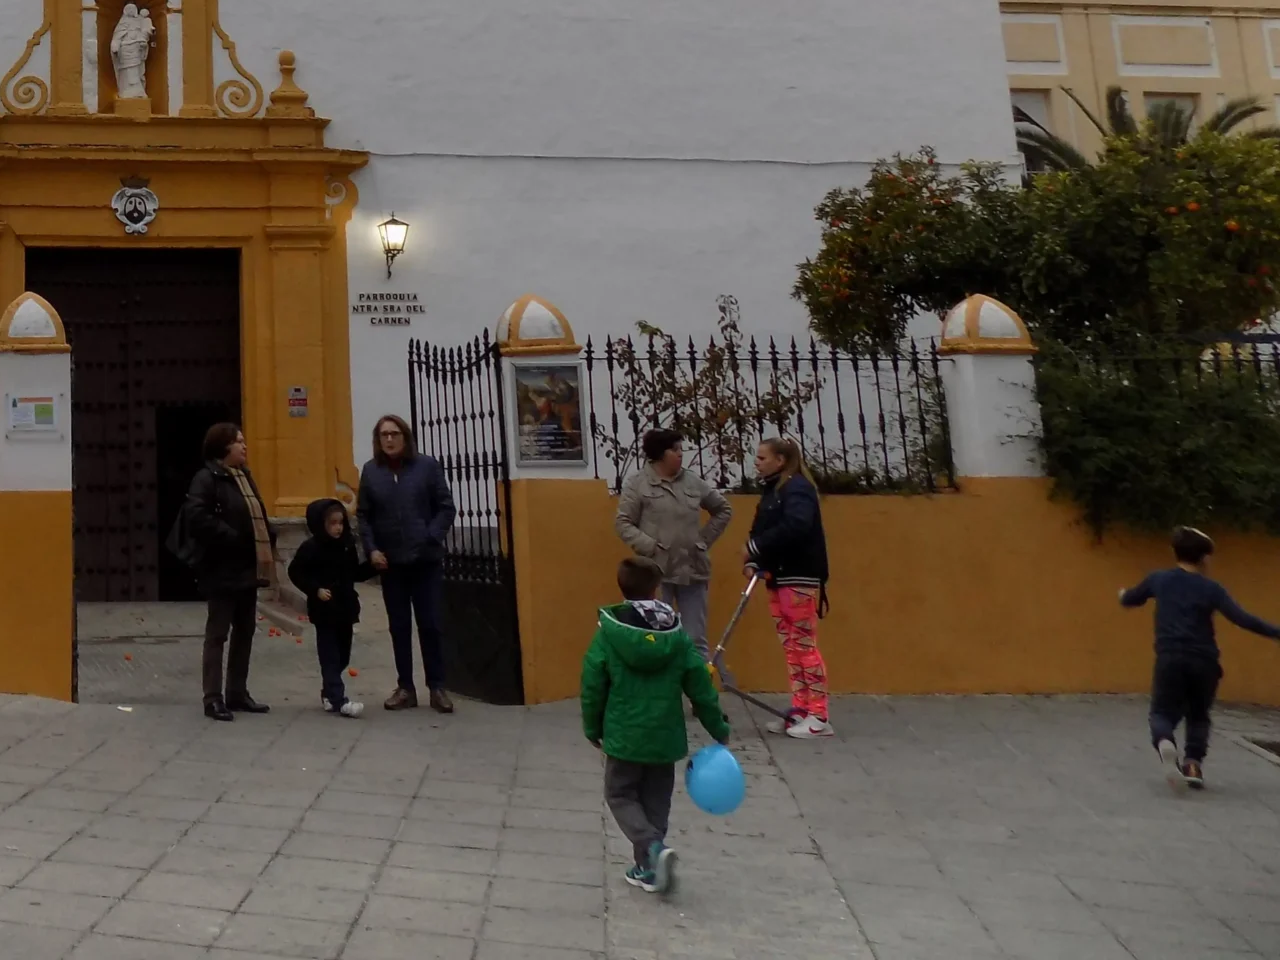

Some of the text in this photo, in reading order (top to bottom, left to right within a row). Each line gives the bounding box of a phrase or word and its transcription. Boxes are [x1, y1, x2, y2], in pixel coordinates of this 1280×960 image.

[358, 292, 419, 301] PARROQUIA
[352, 304, 426, 313] NTRA SRA DEL
